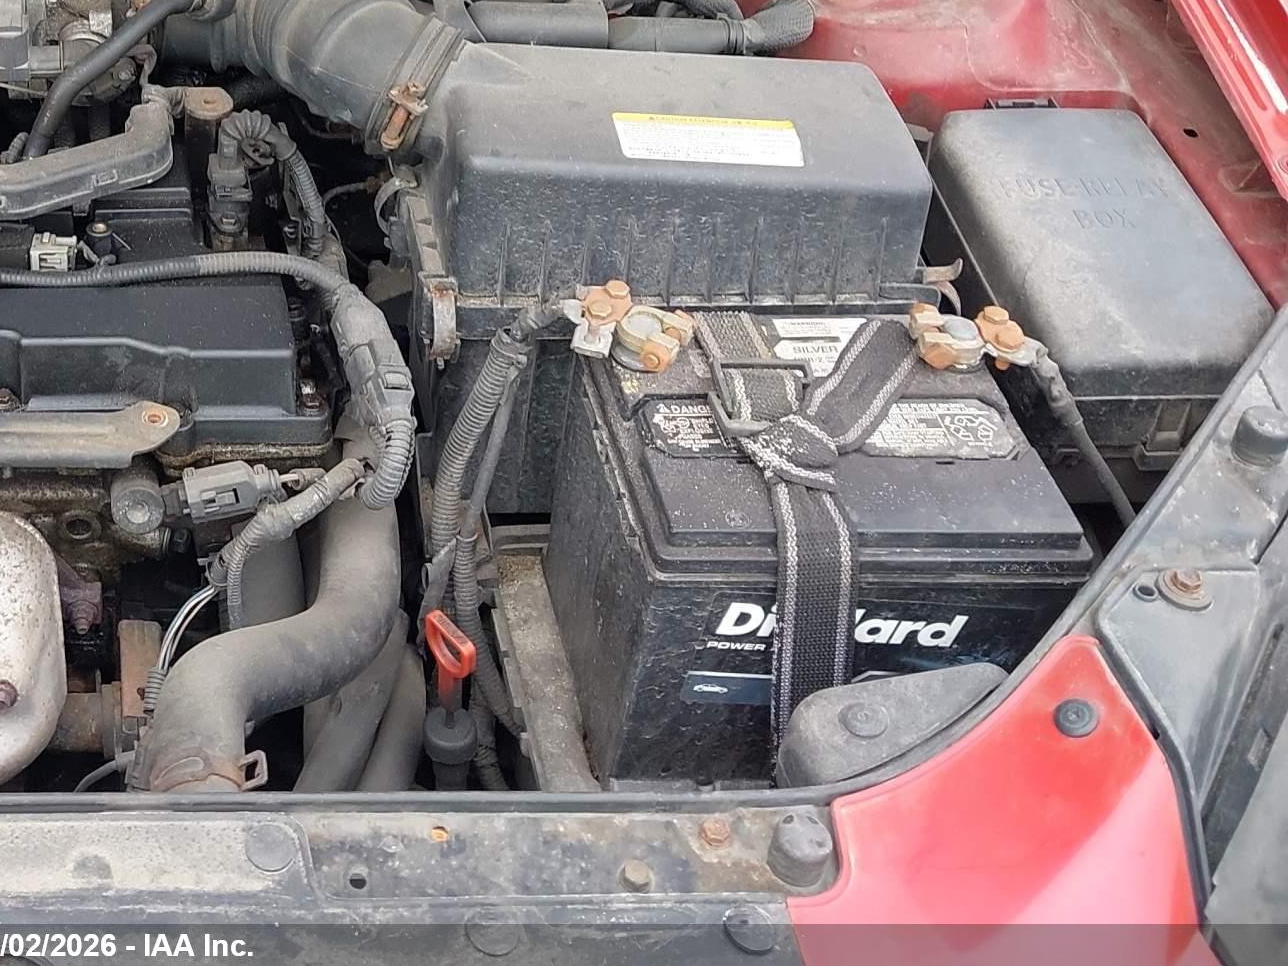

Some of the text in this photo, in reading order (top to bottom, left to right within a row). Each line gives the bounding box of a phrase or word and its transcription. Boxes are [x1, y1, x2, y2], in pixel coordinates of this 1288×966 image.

[1072, 209, 1137, 229] BOX
[792, 345, 840, 355] SILVER
[670, 405, 710, 414] DANG
[715, 601, 969, 648] Diard
[706, 640, 766, 652] POWER
